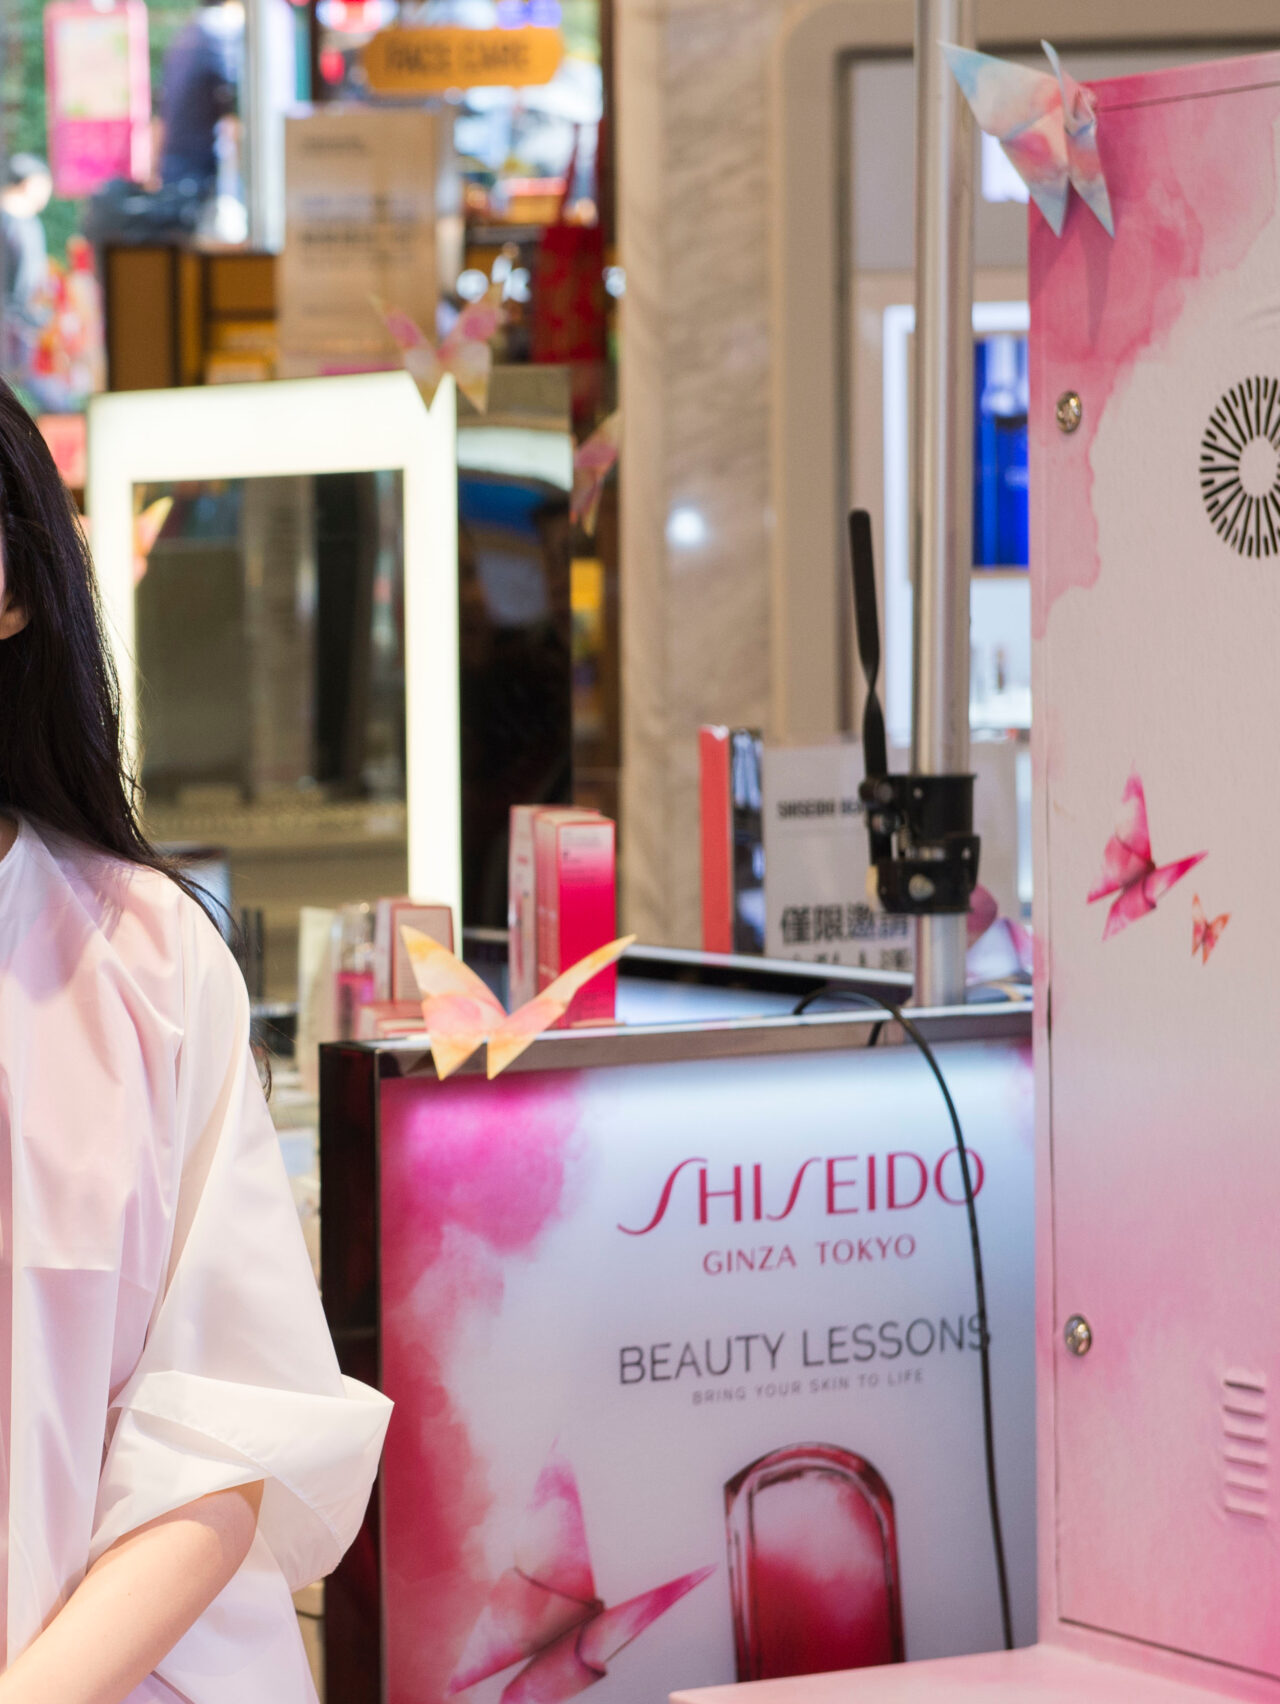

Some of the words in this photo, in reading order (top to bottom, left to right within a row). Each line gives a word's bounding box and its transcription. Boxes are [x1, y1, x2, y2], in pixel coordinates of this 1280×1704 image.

[617, 1147, 985, 1236] SHISEIDO
[703, 1245, 798, 1276] GINZA
[815, 1234, 917, 1266] TOKYO
[619, 1333, 785, 1386] BEAUTY
[802, 1312, 991, 1368] LESSONS
[692, 1386, 747, 1405] BRING
[756, 1380, 802, 1398] YOUR
[809, 1375, 850, 1394] SKIN
[857, 1372, 879, 1388] TO
[887, 1367, 925, 1387] LIFE
